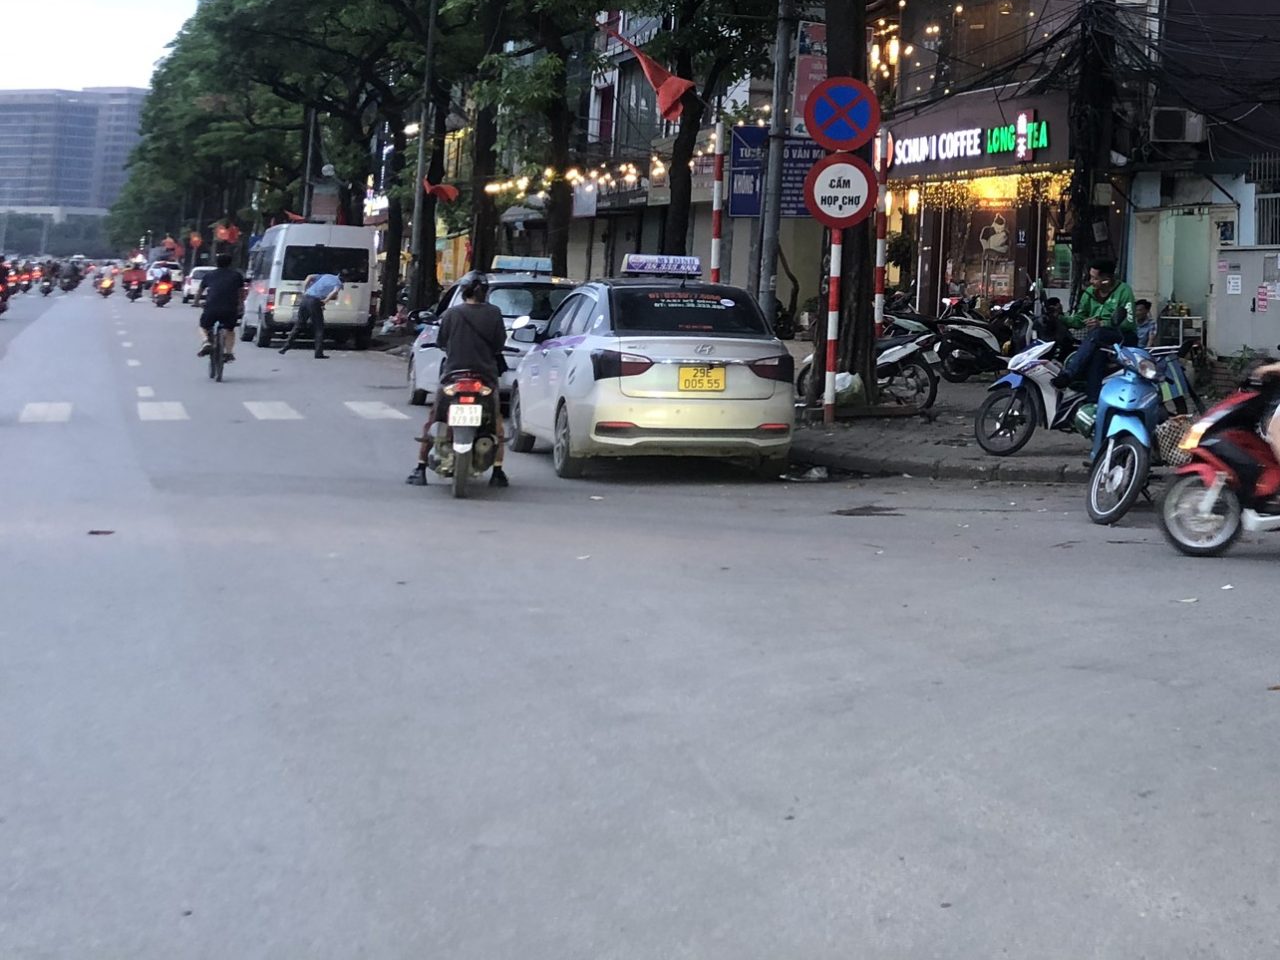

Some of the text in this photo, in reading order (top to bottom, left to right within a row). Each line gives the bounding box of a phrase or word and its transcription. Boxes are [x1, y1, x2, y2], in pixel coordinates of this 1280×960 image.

[938, 127, 982, 160] COFFEE
[987, 124, 1016, 154] LONG
[1026, 120, 1048, 150] TEA
[828, 176, 851, 189] CẤM
[820, 194, 861, 209] HỌP CHỢ
[692, 368, 712, 378] 29E
